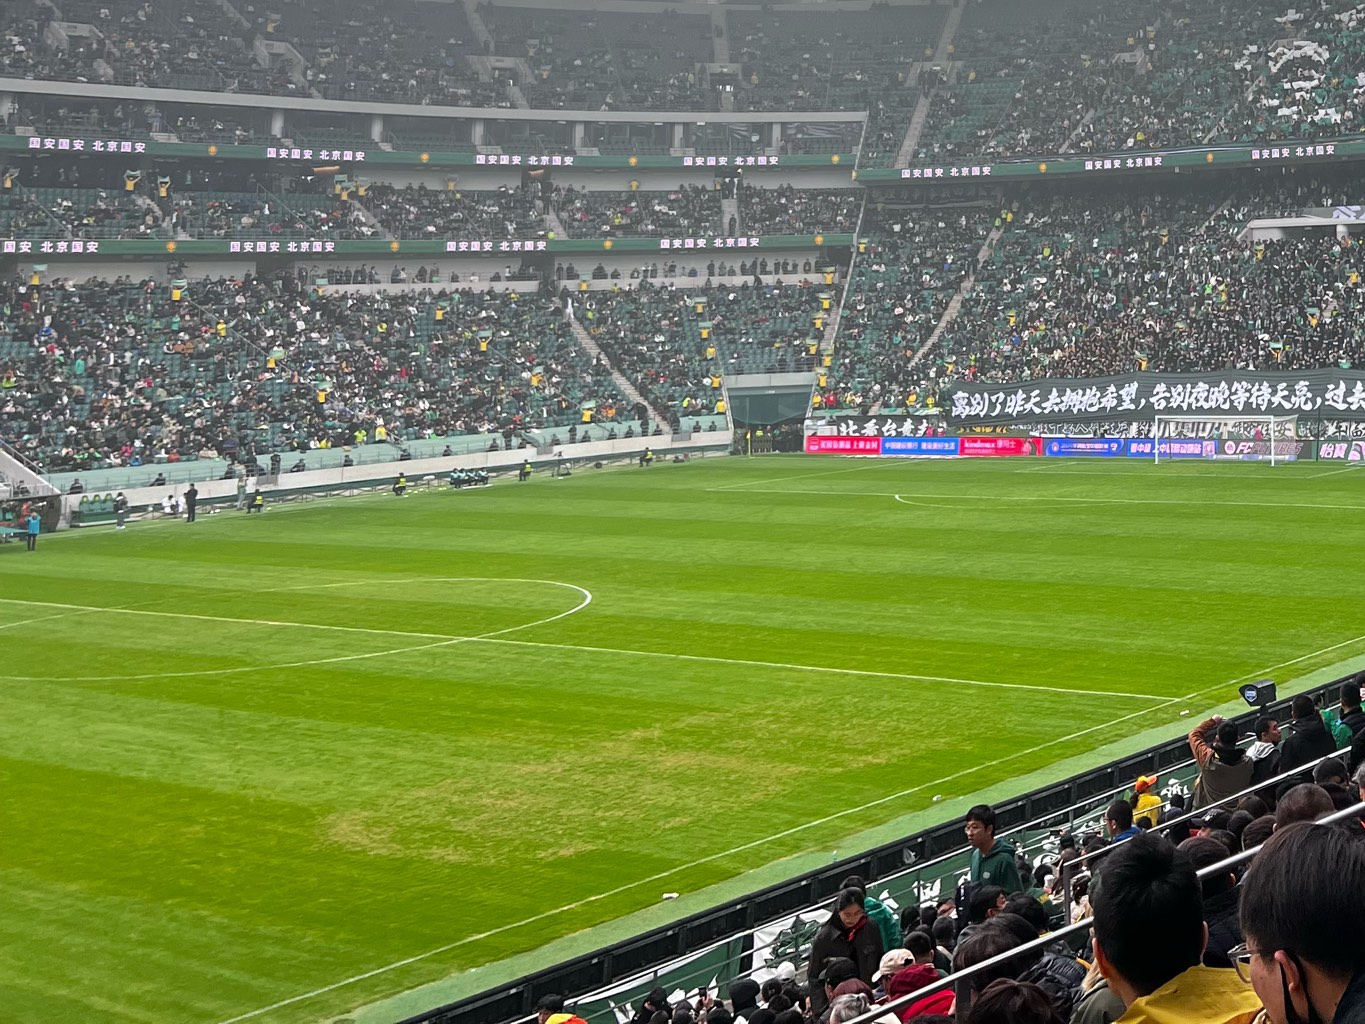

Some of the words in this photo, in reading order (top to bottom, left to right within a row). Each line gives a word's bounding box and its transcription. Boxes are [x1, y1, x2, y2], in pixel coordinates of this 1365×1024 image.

[29, 137, 85, 151] 国安国安
[92, 140, 146, 153] 北京国安
[267, 147, 313, 160] 国安国安
[319, 149, 365, 161] 北京国安
[1252, 147, 1290, 160] 国安国安
[1295, 144, 1335, 157] 北京国安
[476, 154, 522, 165] 国安国安
[528, 155, 574, 166] 北京国安
[684, 156, 728, 166] 国安国安
[735, 156, 779, 166] 北京国安
[1085, 159, 1121, 170] 国安国安
[1126, 156, 1162, 168] 北京国安
[902, 168, 944, 179] 国安国安
[950, 166, 991, 177] 北京国安
[41, 240, 99, 253] 北京国安
[230, 241, 280, 253] 国安国安
[287, 241, 335, 253] 北京国安
[447, 241, 493, 252] 国安国安
[500, 241, 547, 251] 北京国安
[661, 238, 707, 249] 国安国安
[713, 237, 760, 248] 北京国安
[1236, 442, 1254, 454] FC
